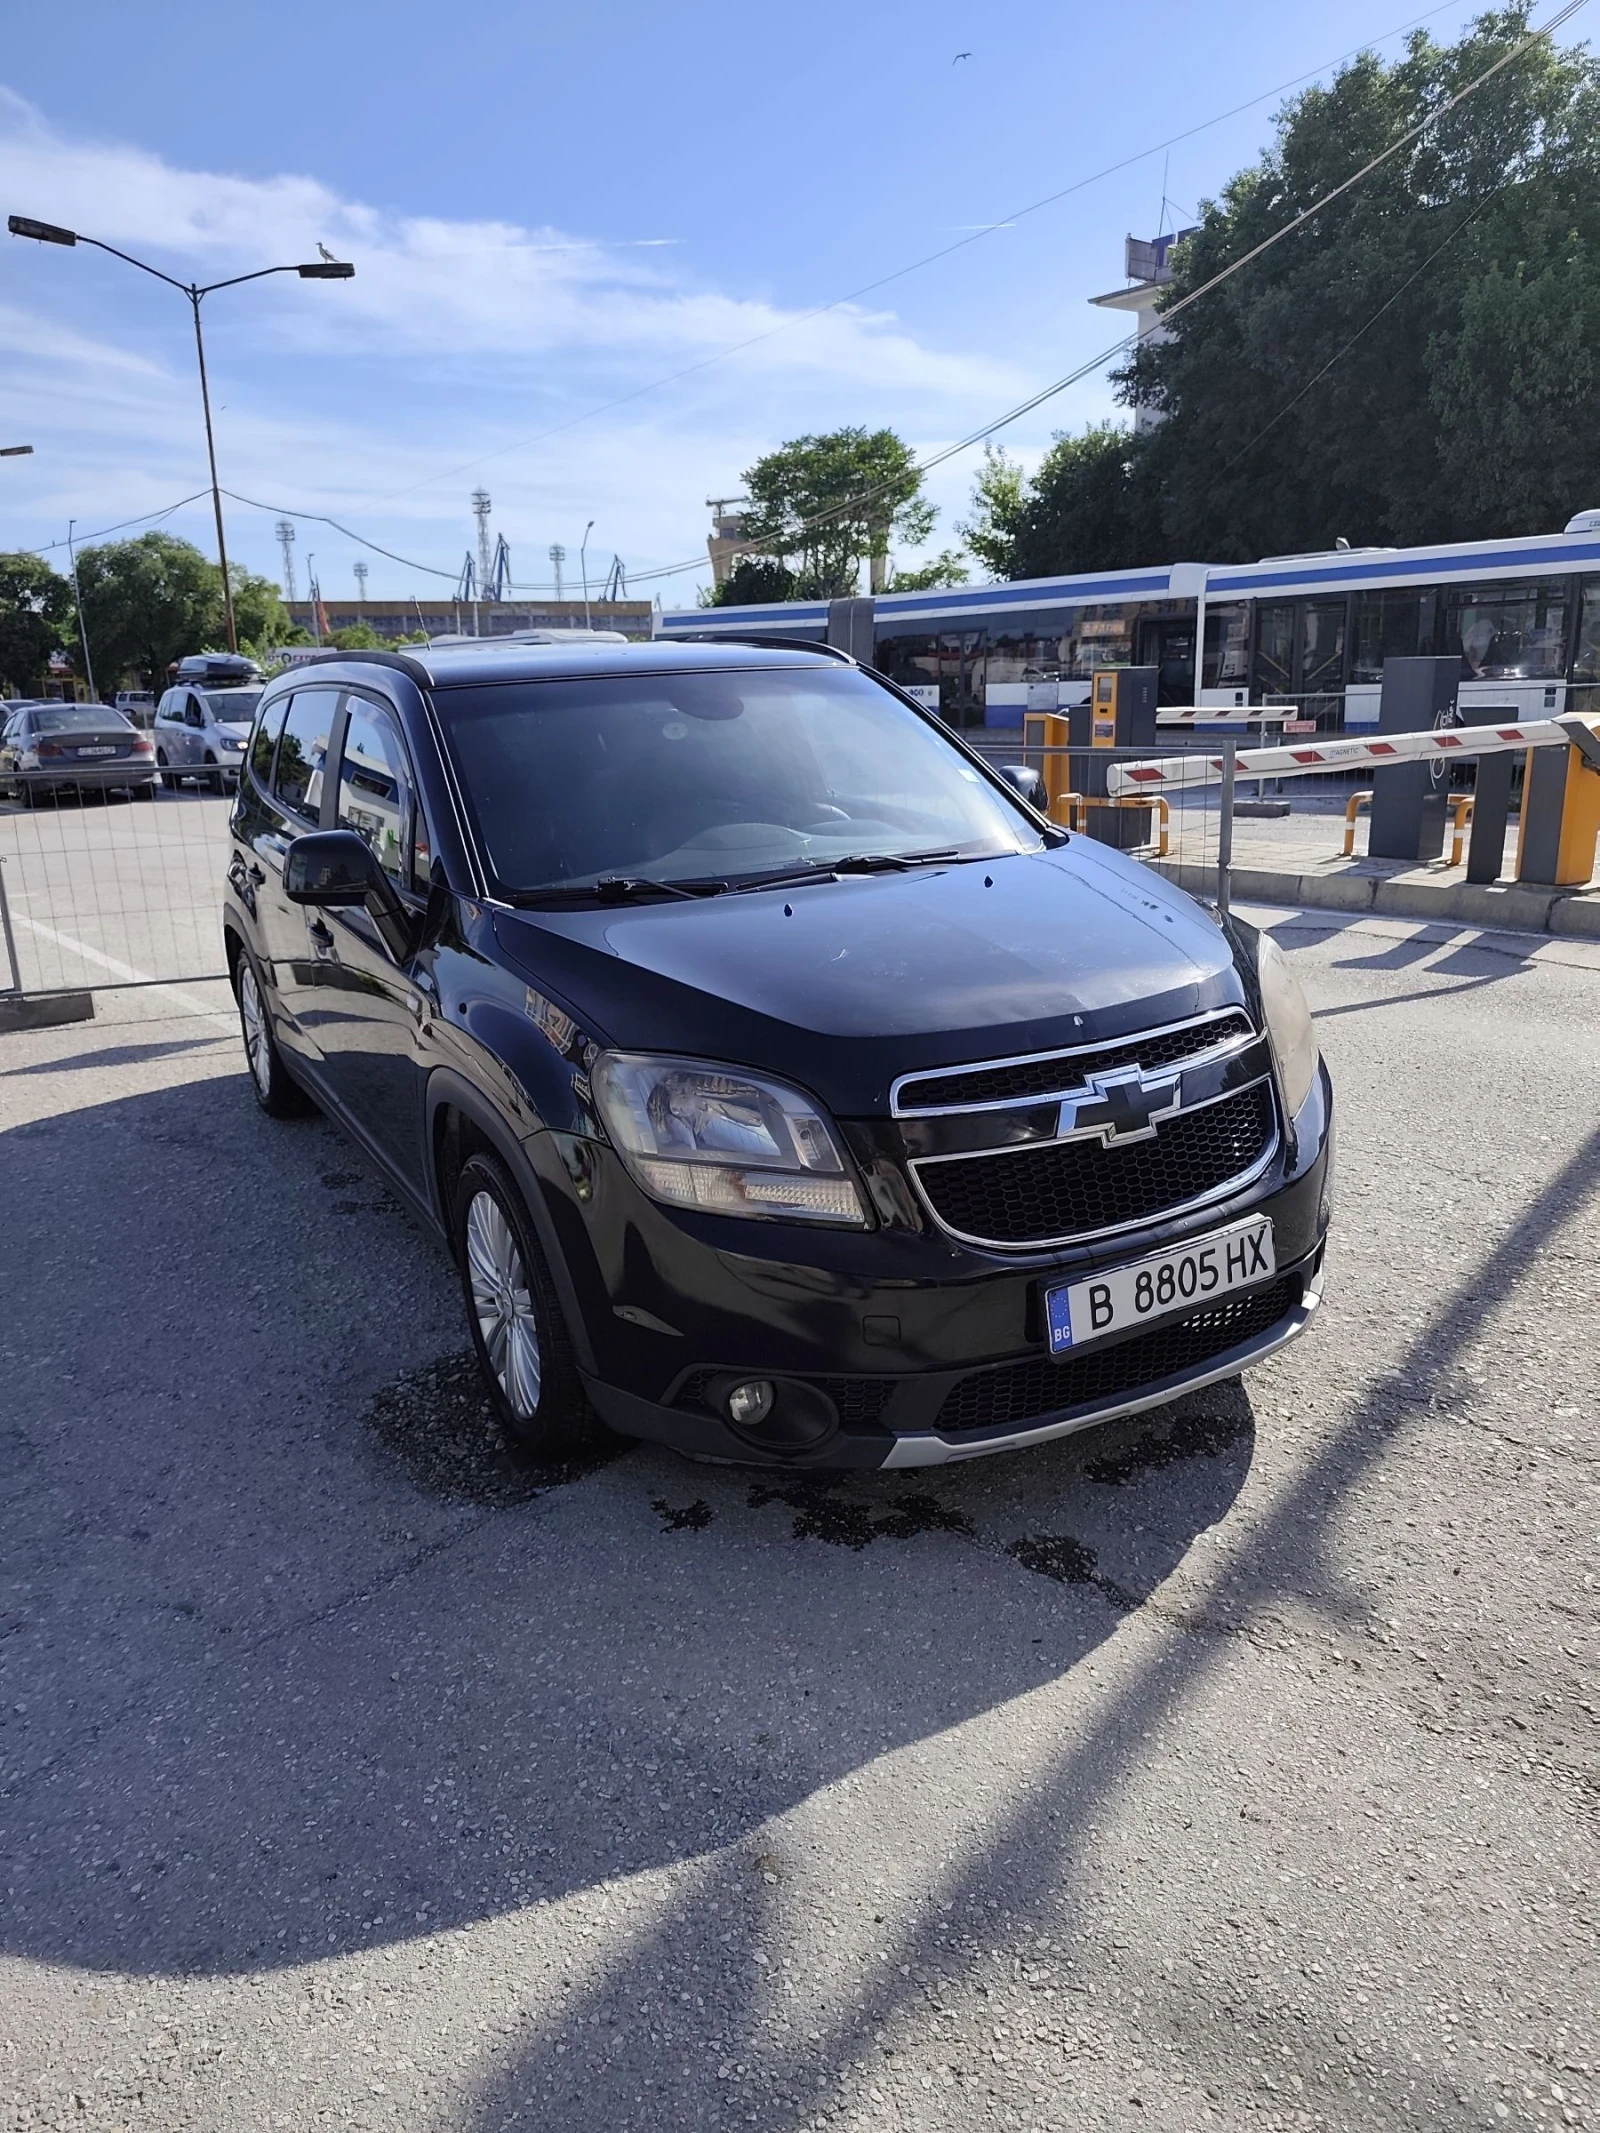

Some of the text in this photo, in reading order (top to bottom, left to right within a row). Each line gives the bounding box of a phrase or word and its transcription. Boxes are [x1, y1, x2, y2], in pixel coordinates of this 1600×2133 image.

[1089, 1229, 1268, 1330] B 8805 HX
[1054, 1325, 1071, 1343] BG
